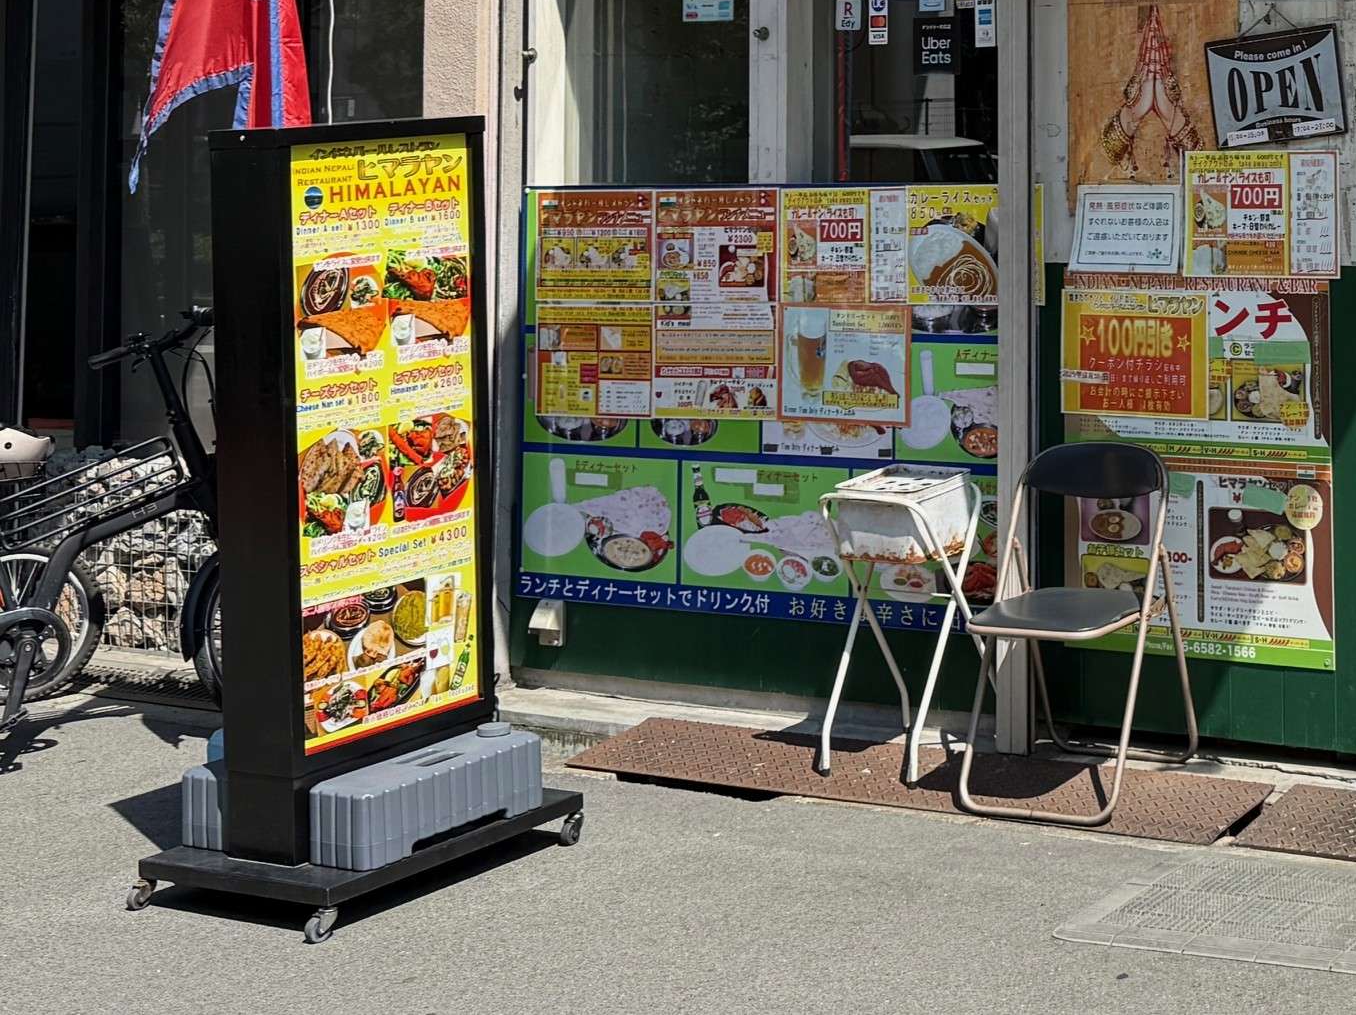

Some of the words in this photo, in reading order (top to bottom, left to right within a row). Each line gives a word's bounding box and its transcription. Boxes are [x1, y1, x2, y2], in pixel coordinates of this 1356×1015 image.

[841, 19, 857, 29] Edy
[921, 37, 952, 50] Uber
[922, 52, 952, 66] Eats
[1234, 49, 1264, 62] Please
[1266, 49, 1291, 61] come
[1227, 53, 1324, 123] OPEN
[357, 154, 462, 181] ヒマラヤン
[297, 175, 353, 187] RESTAURANT
[329, 175, 461, 204] HIMALAYAN
[1232, 187, 1279, 207] 700円
[821, 222, 861, 239] 700円
[1098, 319, 1174, 356] 100円引き
[131, 503, 158, 519] H3
[378, 543, 409, 558] Special
[413, 539, 428, 550] Set
[520, 576, 771, 614] ランチとディナーセットでドリンク付
